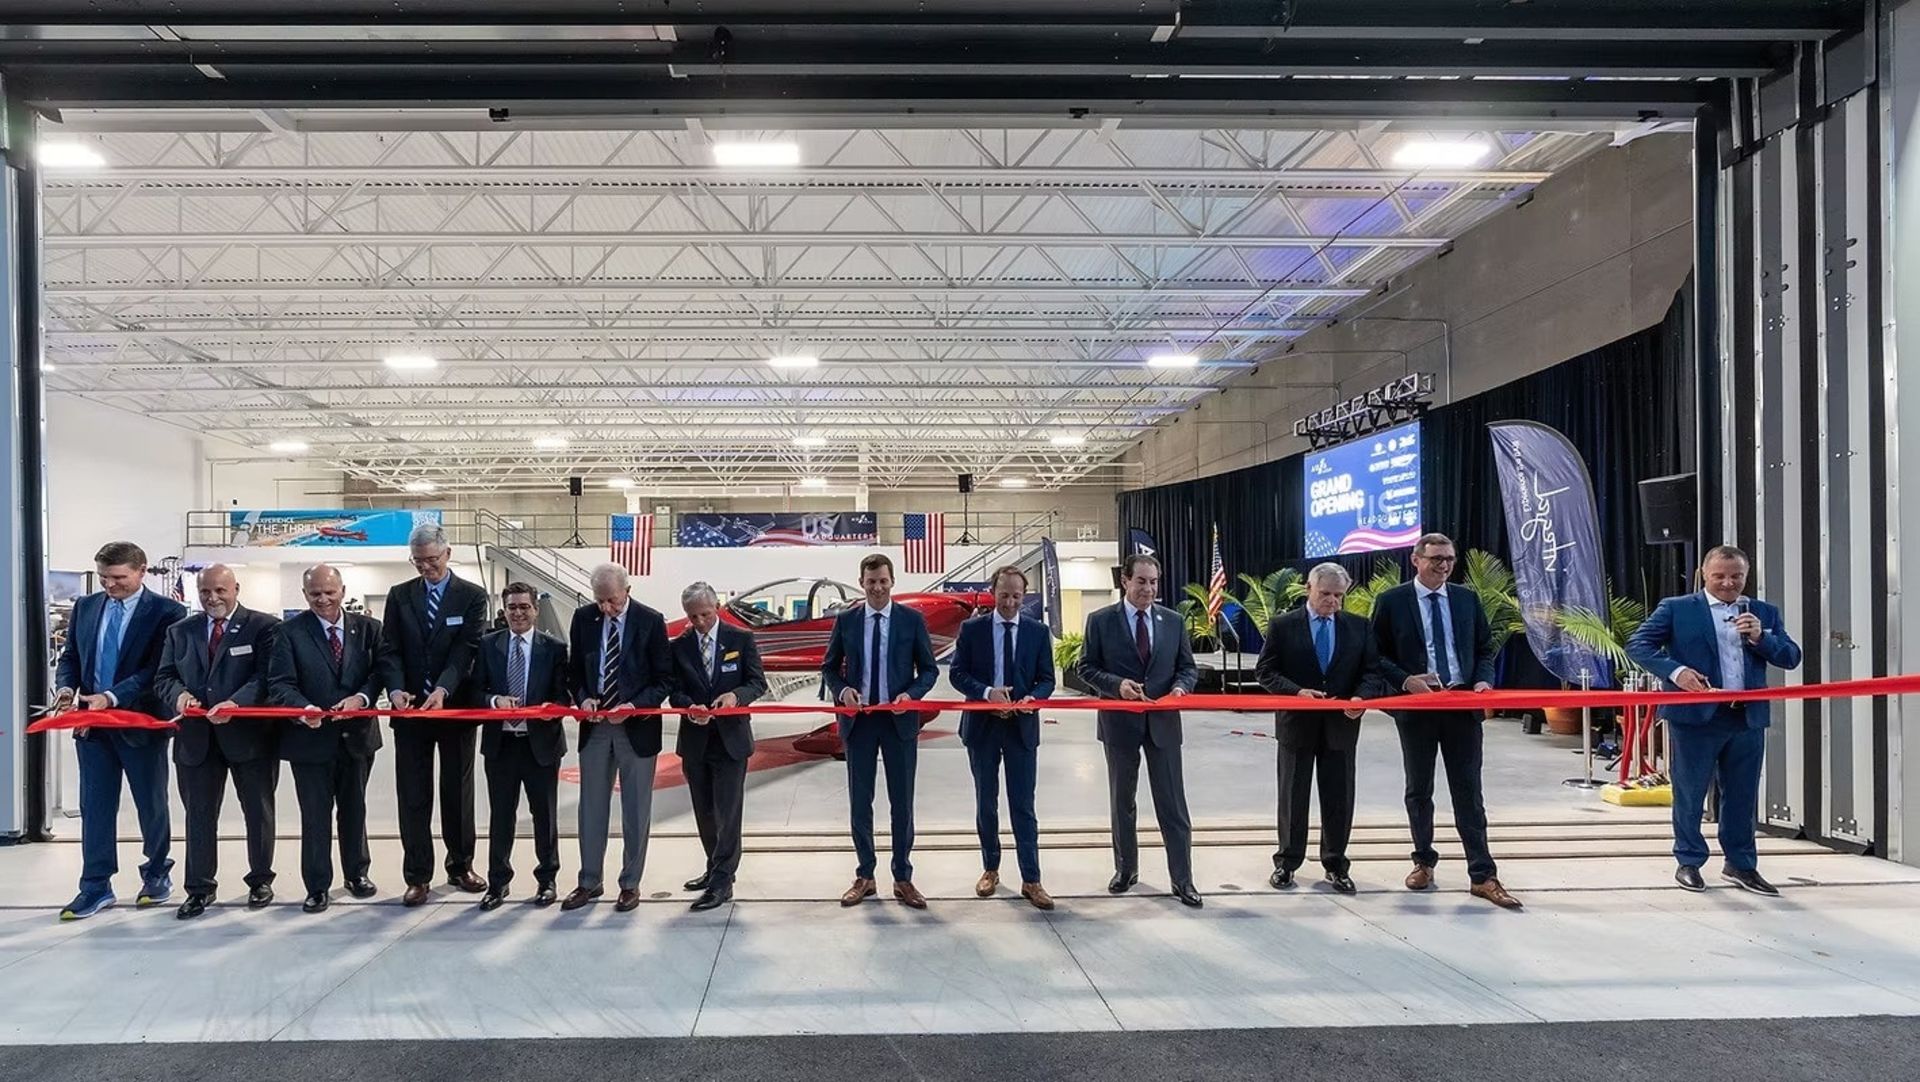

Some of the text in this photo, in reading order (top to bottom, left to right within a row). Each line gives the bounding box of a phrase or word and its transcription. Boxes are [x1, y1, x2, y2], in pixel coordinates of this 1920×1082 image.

[1310, 473, 1352, 499] GRAND
[1310, 490, 1365, 517] OPENING
[256, 516, 294, 524] EXPERIENCE
[801, 516, 834, 537] US
[256, 523, 319, 535] THE THRILL
[802, 533, 874, 541] HEADQUARTERS
